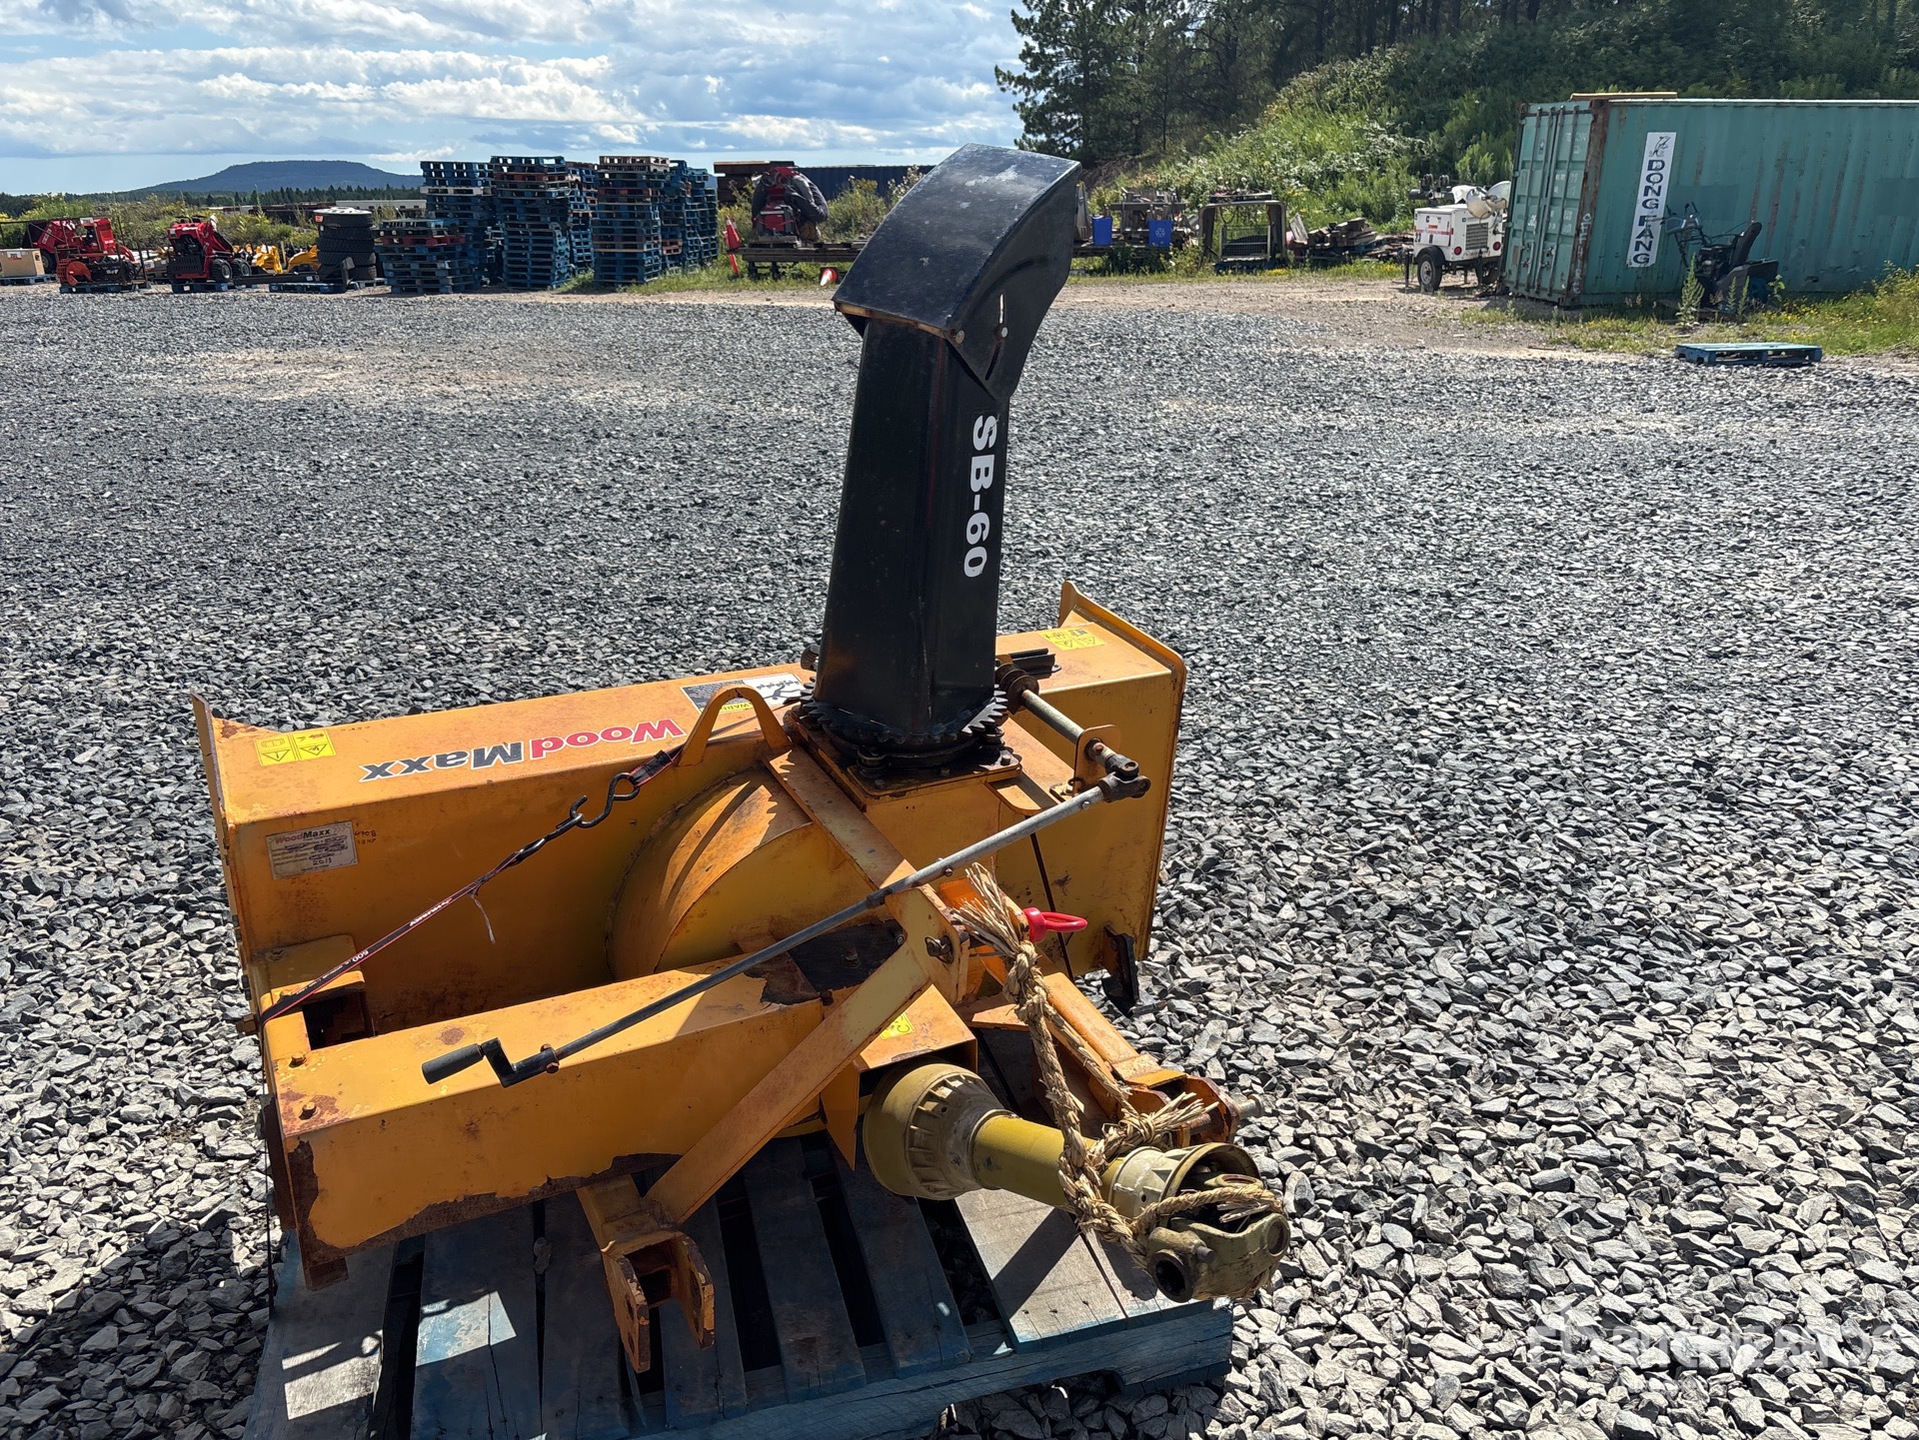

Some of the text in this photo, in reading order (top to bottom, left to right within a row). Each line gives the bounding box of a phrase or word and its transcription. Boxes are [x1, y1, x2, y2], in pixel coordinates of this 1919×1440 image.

[1632, 159, 1665, 264] DONG FANG
[963, 414, 998, 578] SB-60
[358, 718, 687, 783] WoodMaxx
[275, 828, 331, 844] WoodMaxx
